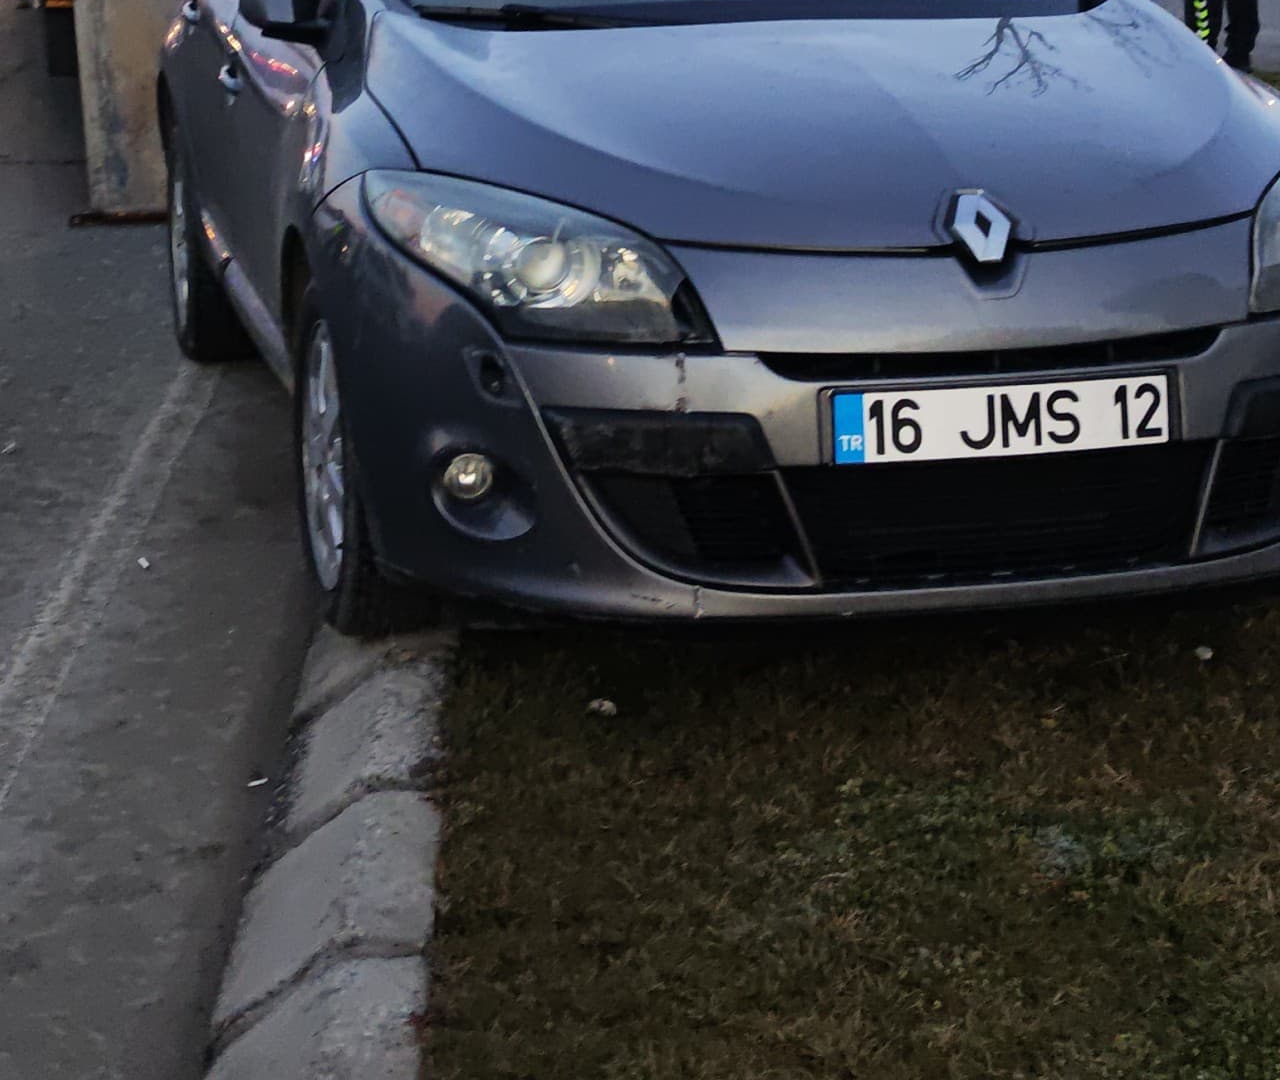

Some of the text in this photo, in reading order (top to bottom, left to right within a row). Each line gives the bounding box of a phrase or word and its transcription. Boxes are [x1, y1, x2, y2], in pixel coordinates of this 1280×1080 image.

[838, 383, 1163, 455] TR 16 JMS 12
